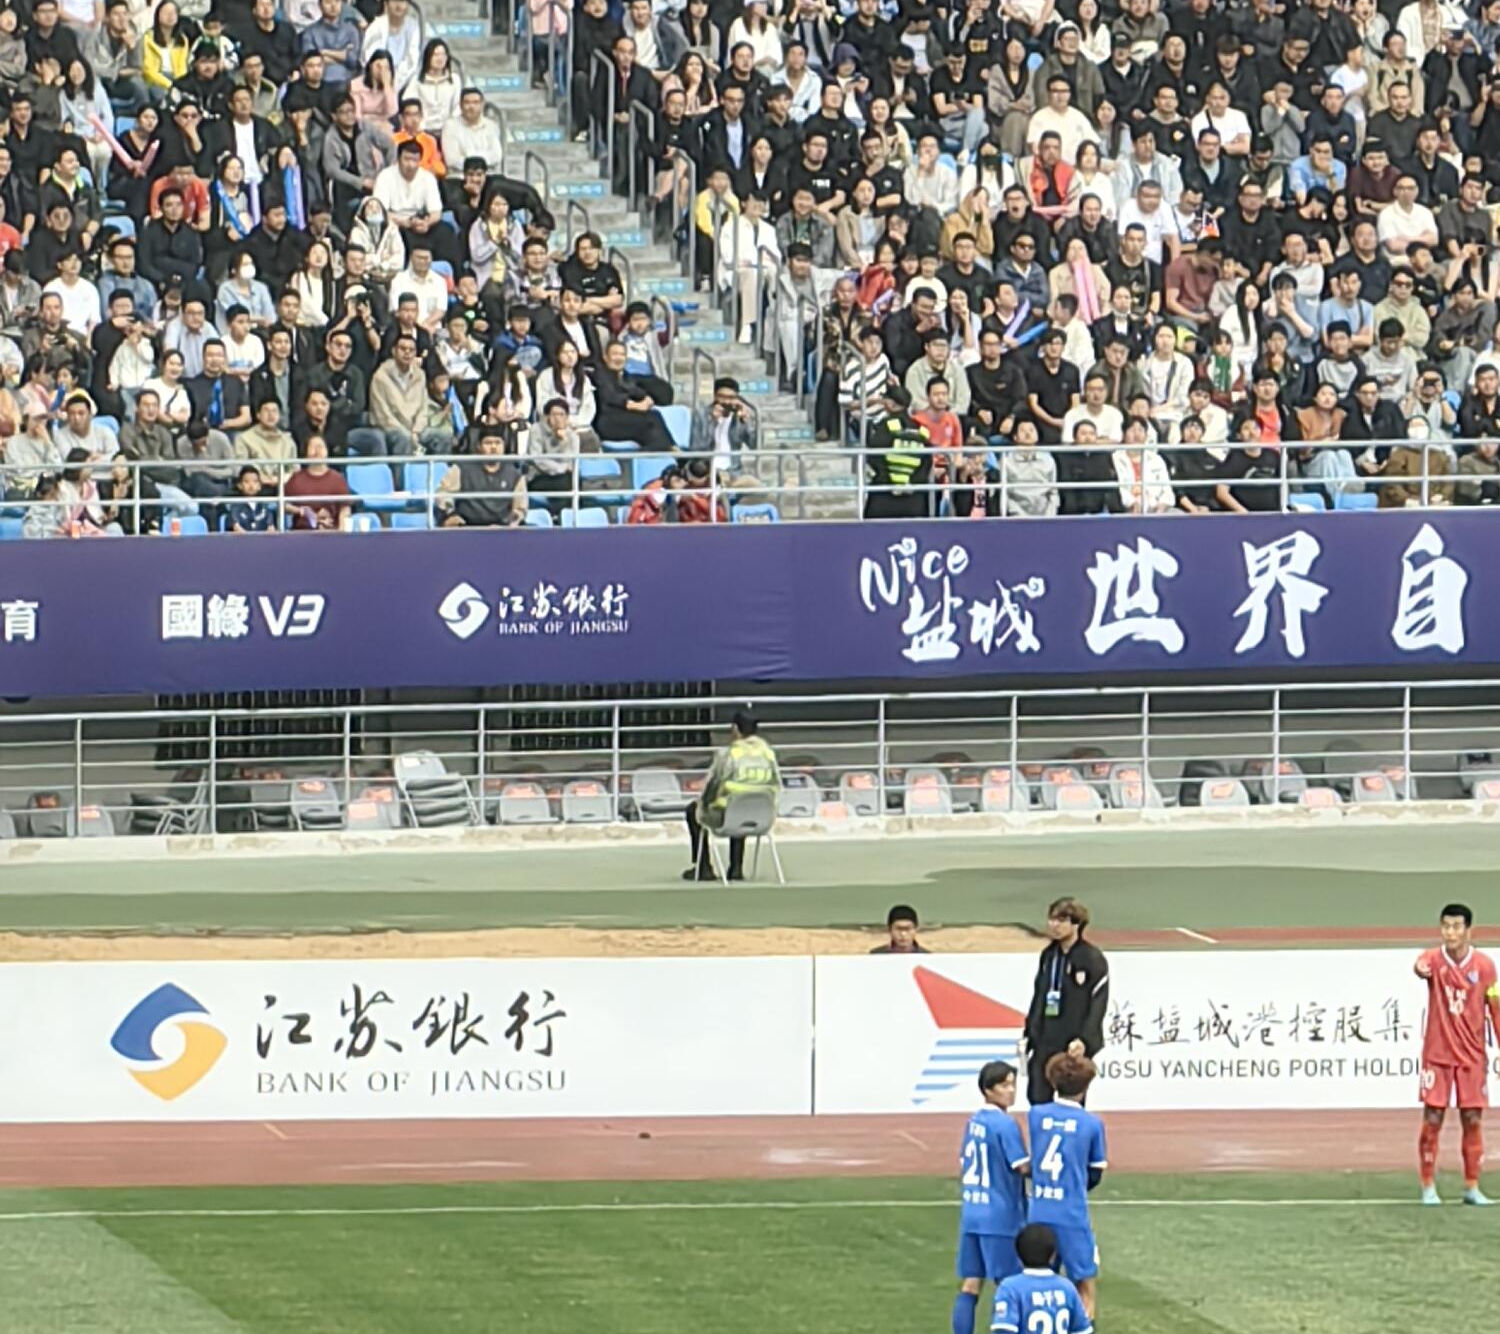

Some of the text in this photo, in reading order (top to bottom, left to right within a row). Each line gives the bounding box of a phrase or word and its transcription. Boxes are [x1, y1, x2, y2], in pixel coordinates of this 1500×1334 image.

[860, 537, 969, 612] Nice
[0, 599, 39, 642] 育
[258, 593, 325, 637] V3
[499, 620, 629, 636] BANK OF JIANGSU
[902, 575, 1046, 663] 盐城
[256, 1069, 568, 1097] BANK OF JIANGSU
[1098, 1058, 1152, 1079] NGSU
[1160, 1058, 1281, 1078] YANCHENG
[1288, 1058, 1347, 1078] PORT
[1353, 1057, 1420, 1078] HOLDI
[963, 1139, 990, 1189] 21
[1040, 1133, 1064, 1182] 4
